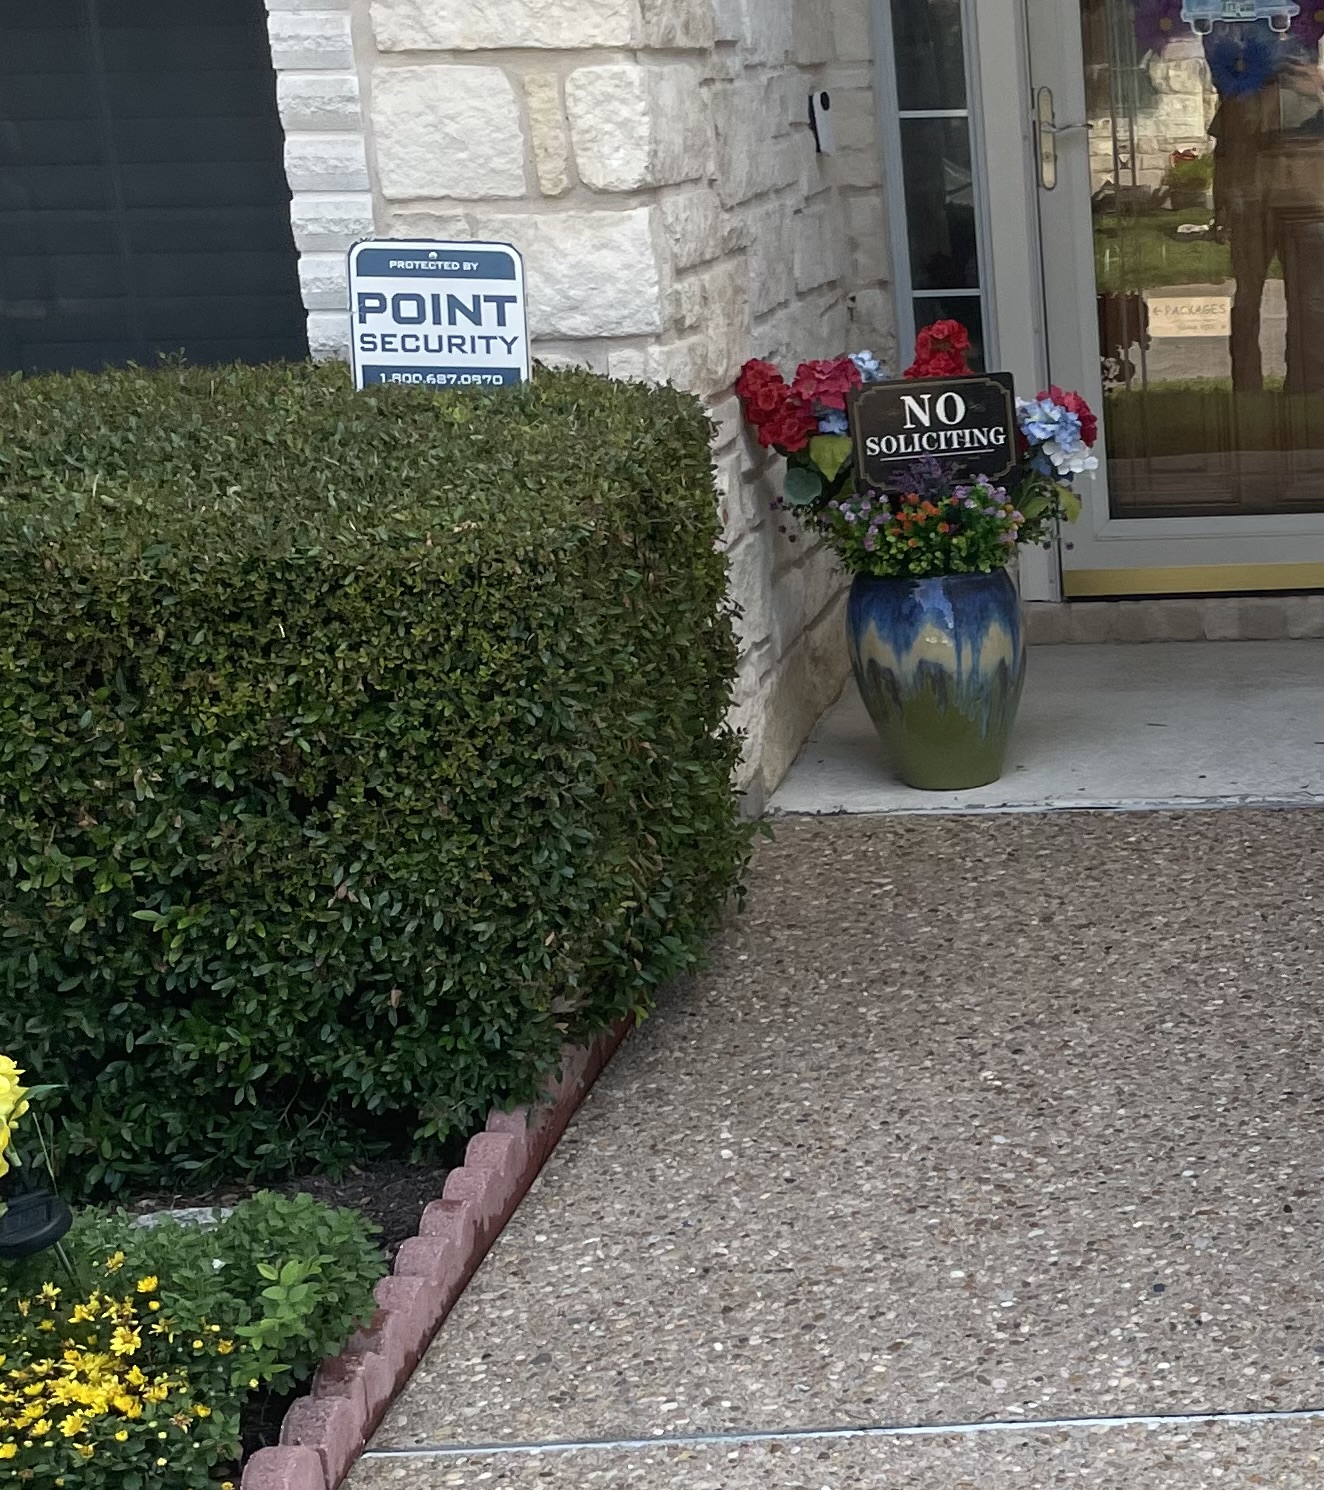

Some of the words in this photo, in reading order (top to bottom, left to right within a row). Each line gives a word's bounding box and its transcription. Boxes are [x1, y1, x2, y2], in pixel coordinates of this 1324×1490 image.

[389, 260, 460, 270] PROTECTED
[462, 261, 479, 271] BY
[357, 292, 518, 327] POINT
[360, 333, 519, 354] SECURITY
[900, 391, 966, 429] NO
[865, 426, 1006, 456] SOLICITING
